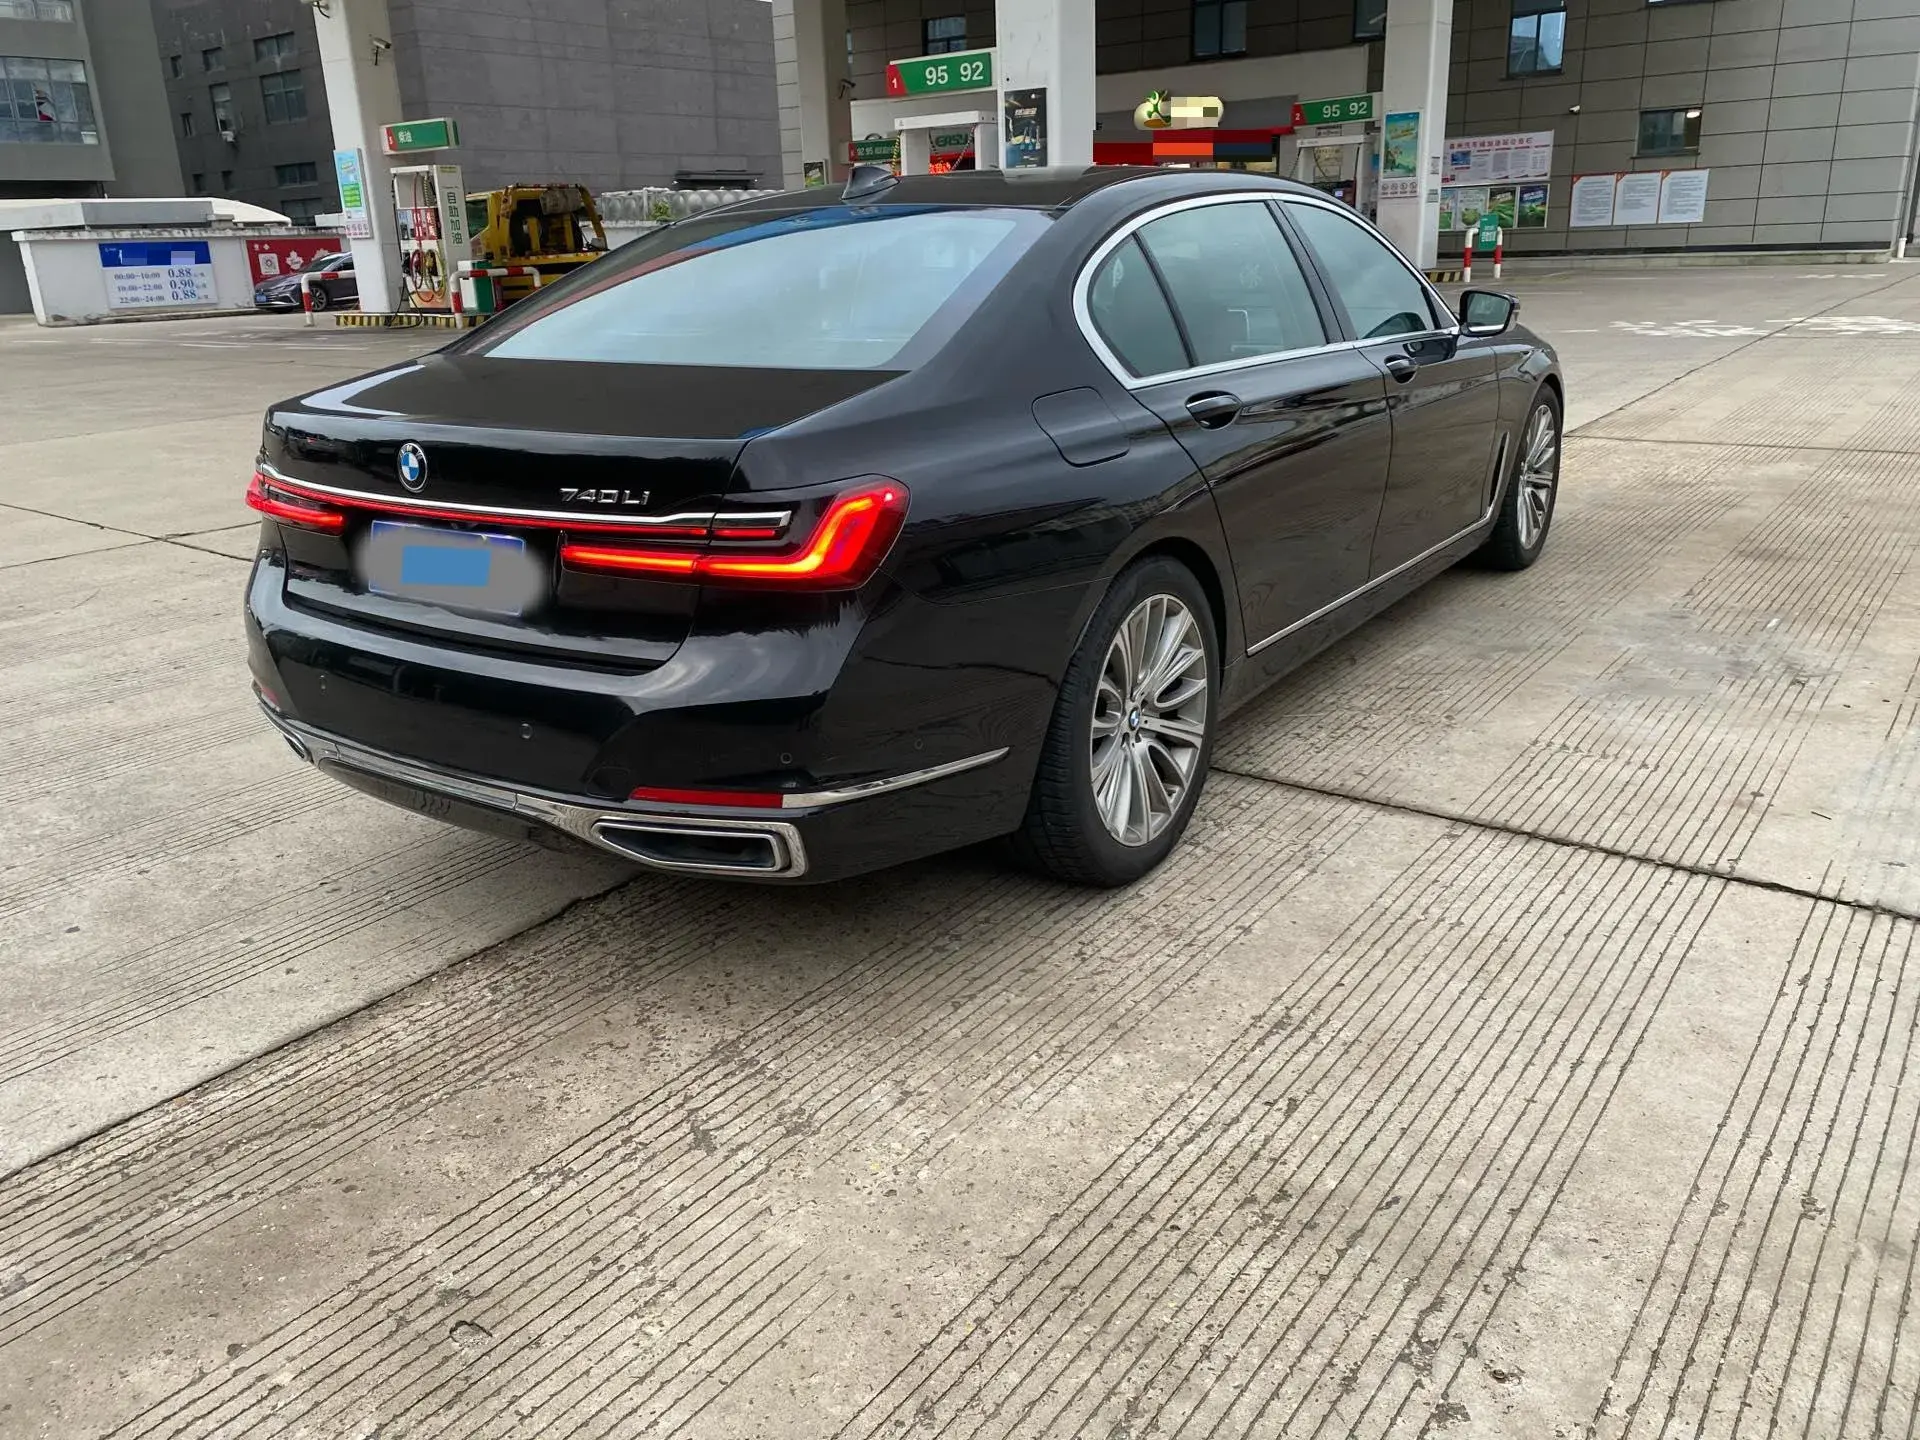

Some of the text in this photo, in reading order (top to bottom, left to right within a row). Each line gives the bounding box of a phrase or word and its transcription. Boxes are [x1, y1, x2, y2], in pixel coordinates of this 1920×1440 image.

[891, 61, 984, 89] 1 95 92
[1322, 104, 1341, 118] 95
[1349, 101, 1367, 116] 92
[447, 191, 463, 245] 自助加油
[168, 268, 192, 279] 0.88
[170, 279, 195, 290] 0.90
[172, 289, 197, 301] 0.88
